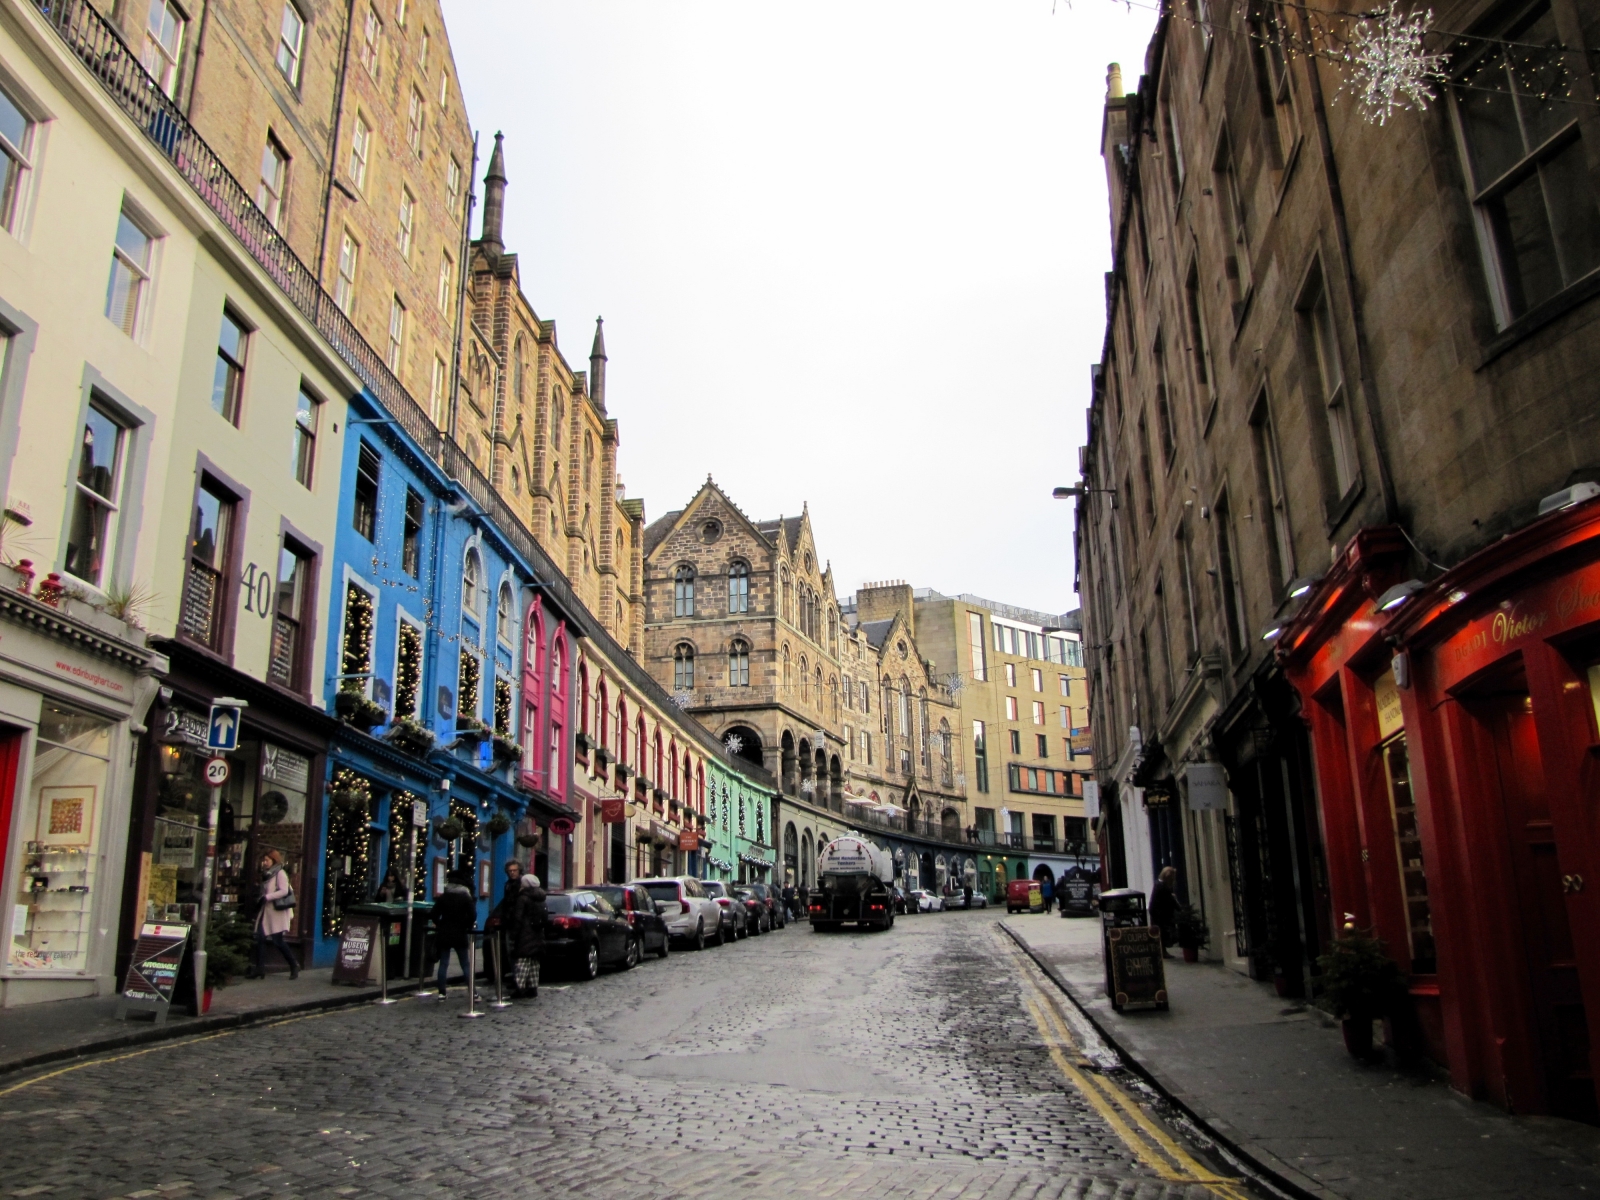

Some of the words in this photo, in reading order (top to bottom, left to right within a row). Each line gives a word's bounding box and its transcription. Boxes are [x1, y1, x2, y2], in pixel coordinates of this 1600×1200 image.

[240, 562, 271, 619] 40
[1491, 600, 1549, 646] Victor
[55, 660, 124, 692] www.edinburghart.com
[208, 765, 227, 777] 20
[342, 941, 369, 951] MUSEUM
